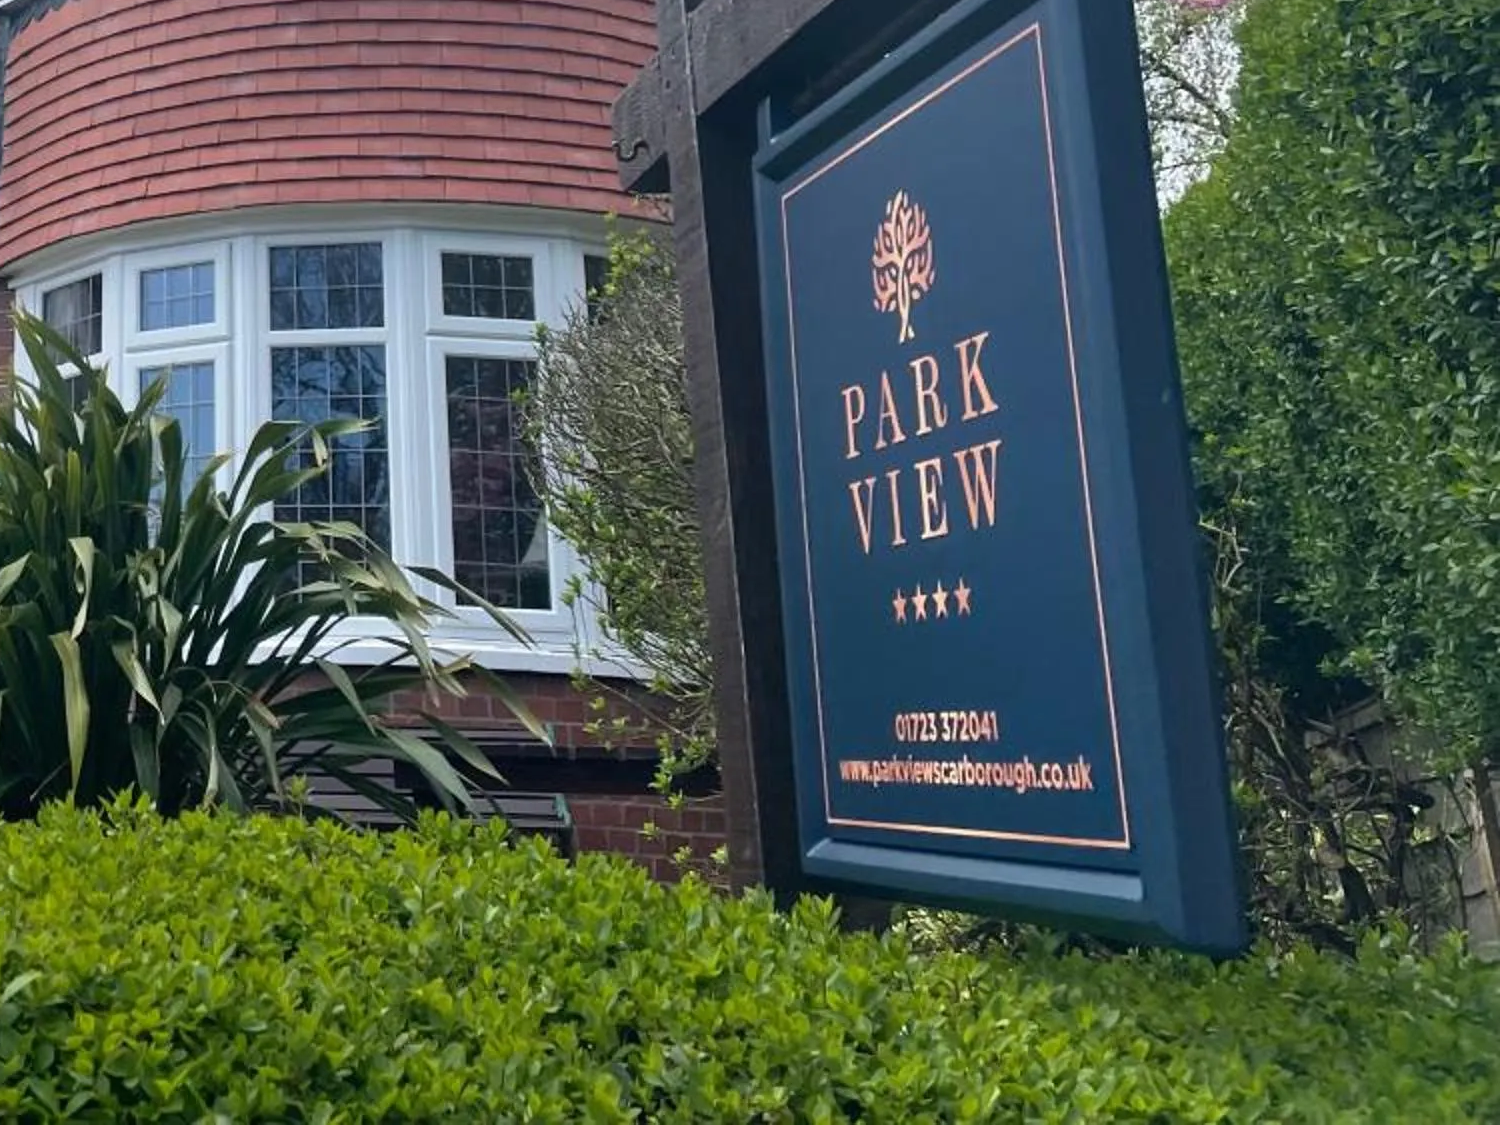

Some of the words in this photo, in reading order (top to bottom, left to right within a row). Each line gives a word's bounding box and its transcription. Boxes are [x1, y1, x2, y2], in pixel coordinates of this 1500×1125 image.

[840, 331, 999, 459] PARK
[848, 439, 1002, 555] VIEW
[895, 711, 938, 742] 01723
[940, 711, 999, 742] 372041
[839, 755, 1094, 793] www.parkviewscarborough.co.uk
